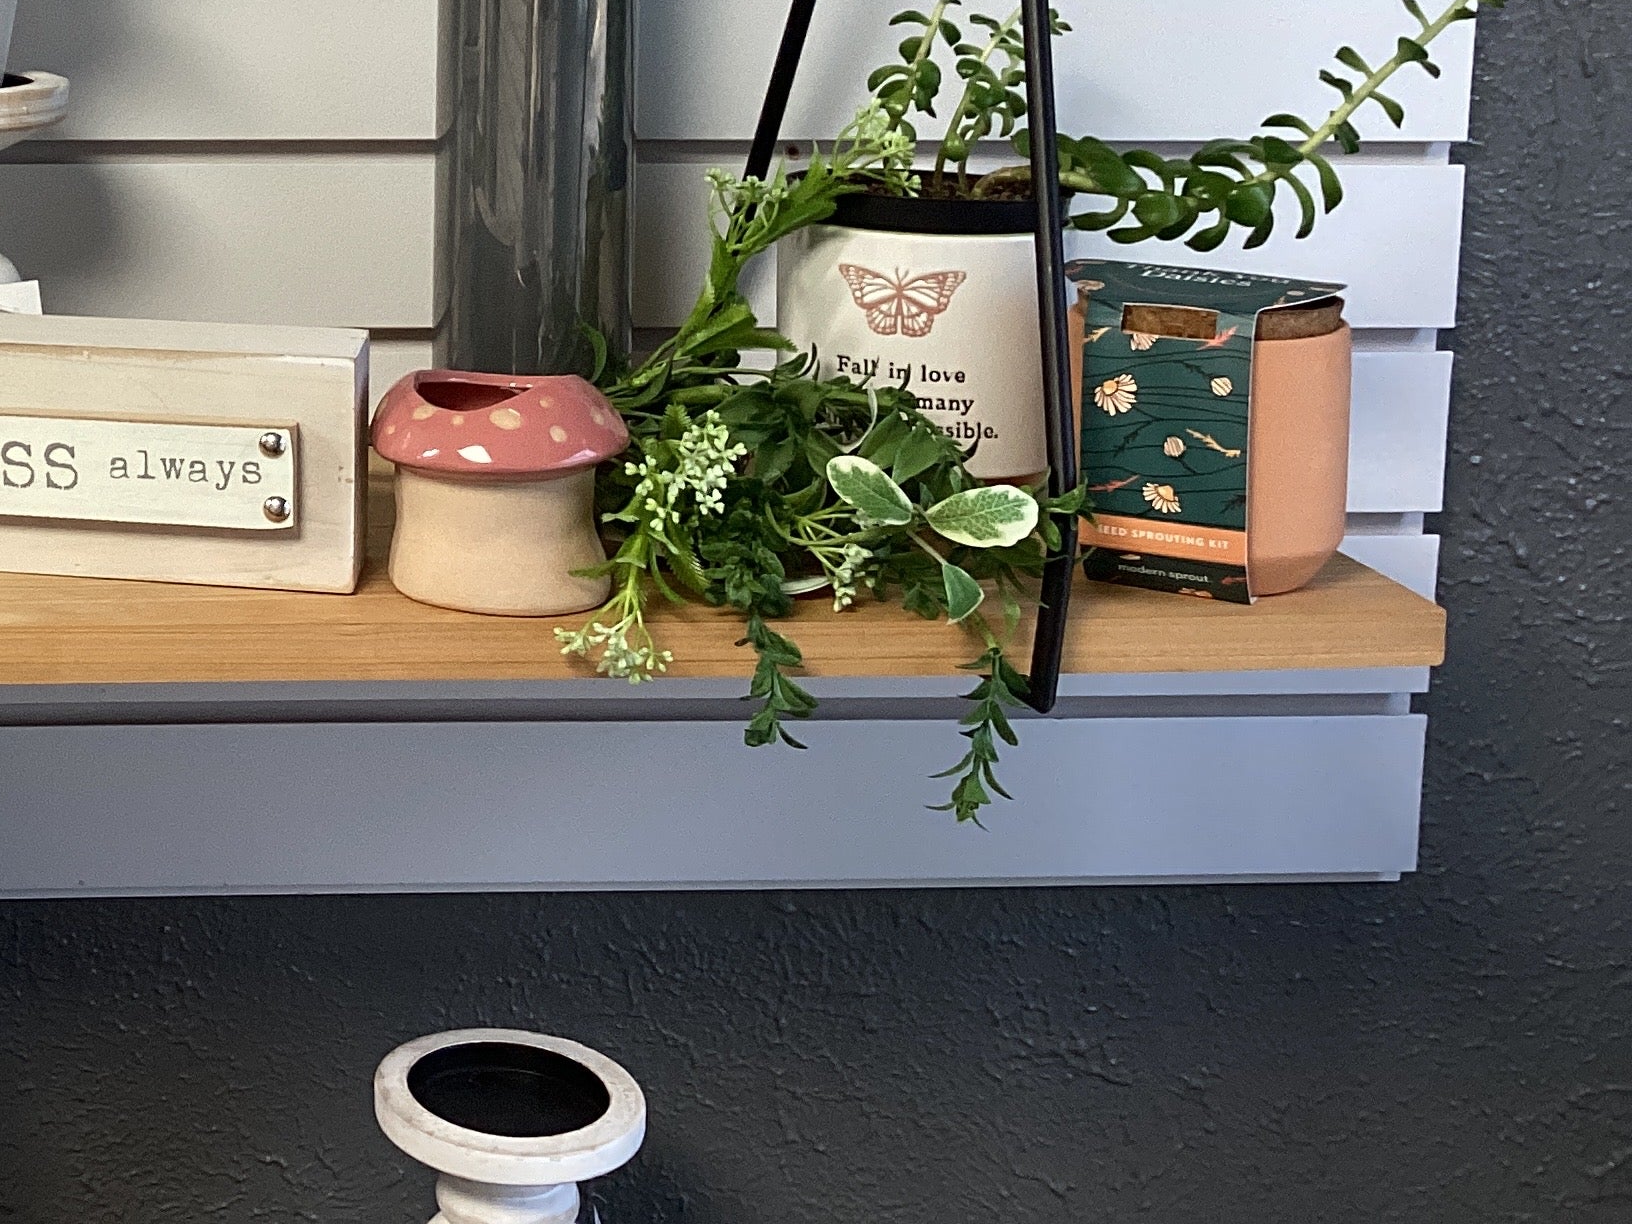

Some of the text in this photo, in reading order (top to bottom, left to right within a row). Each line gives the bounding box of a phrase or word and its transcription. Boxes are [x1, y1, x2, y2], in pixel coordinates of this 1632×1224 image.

[837, 354, 966, 383] Fall in love
[916, 396, 975, 416] many
[109, 450, 262, 491] always
[1131, 528, 1204, 546] SPROUTING
[1209, 540, 1229, 549] KIT
[1118, 563, 1209, 583] modern sprout
